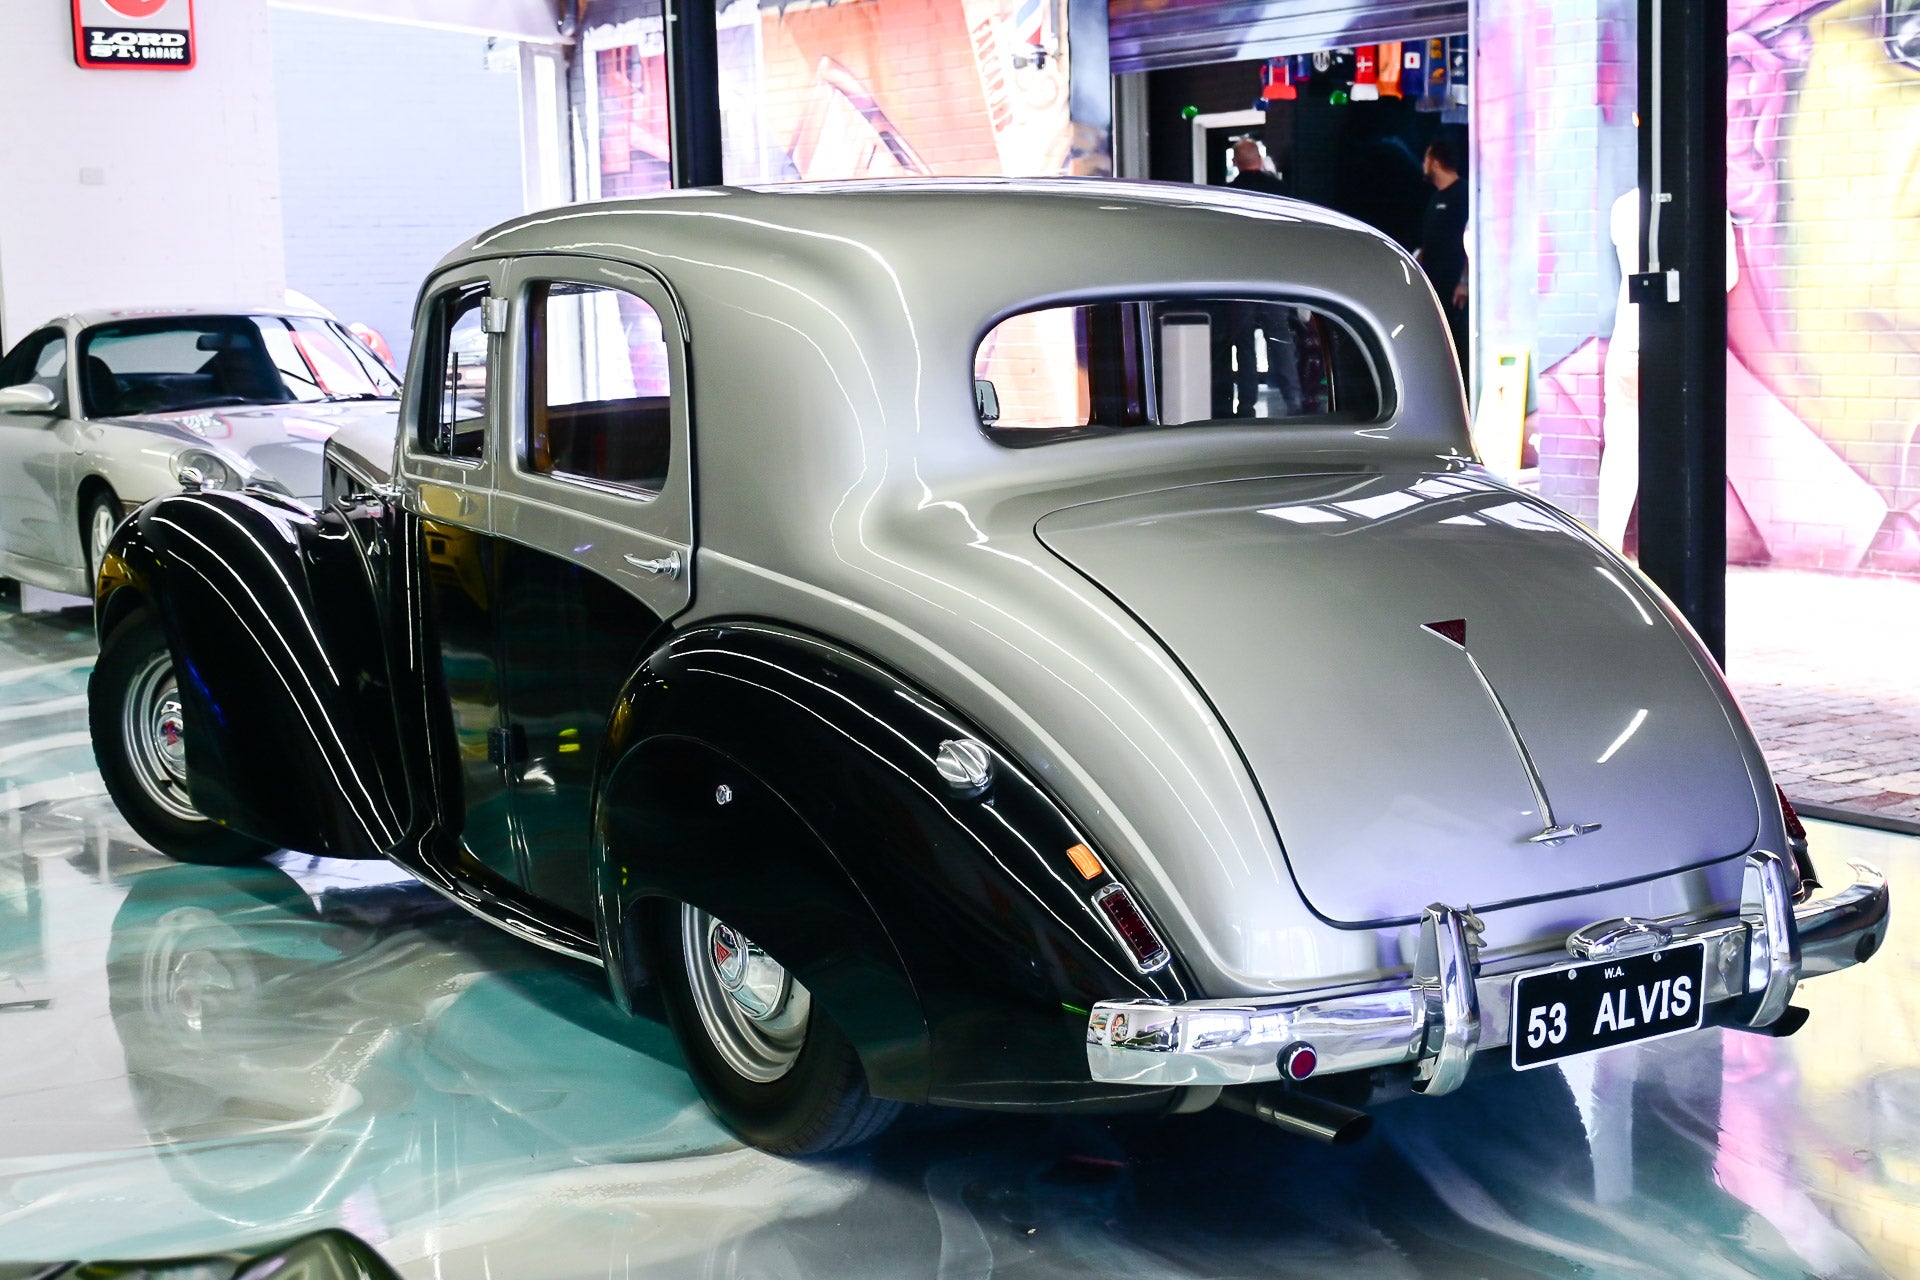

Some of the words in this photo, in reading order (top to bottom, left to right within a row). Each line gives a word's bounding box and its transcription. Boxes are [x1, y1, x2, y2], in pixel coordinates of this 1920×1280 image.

[90, 31, 187, 46] LORD
[90, 44, 140, 58] ST.
[1604, 966, 1625, 979] W.A.
[1527, 1002, 1567, 1049] 53
[1592, 975, 1692, 1035] ALVIS
